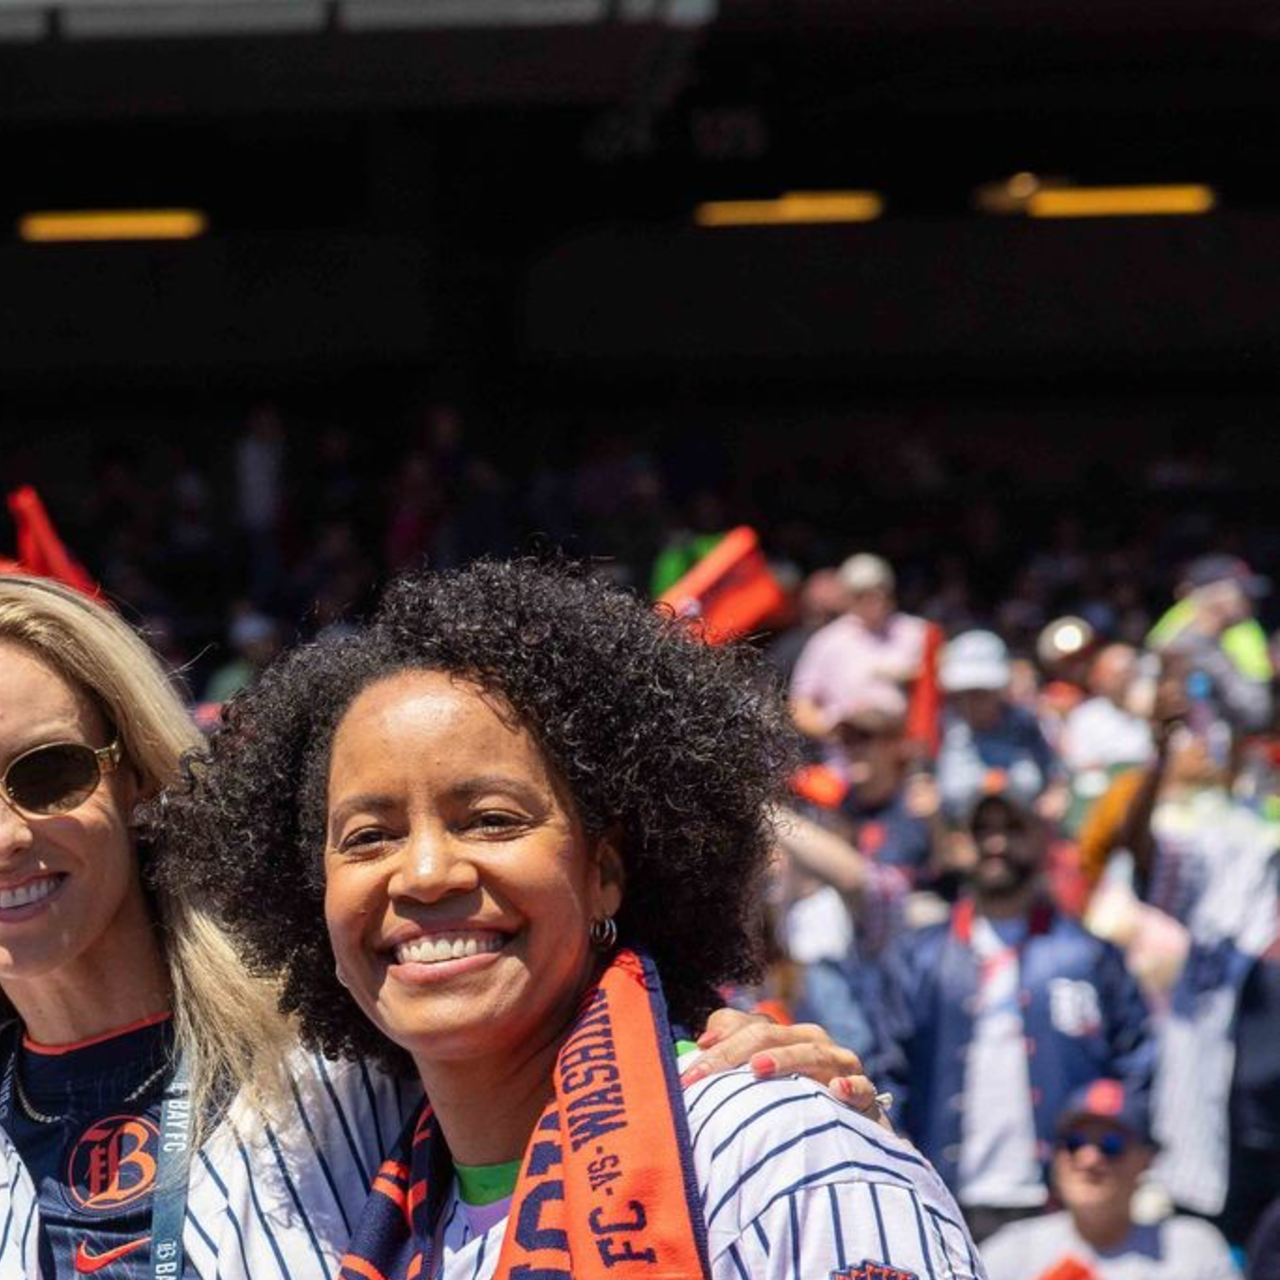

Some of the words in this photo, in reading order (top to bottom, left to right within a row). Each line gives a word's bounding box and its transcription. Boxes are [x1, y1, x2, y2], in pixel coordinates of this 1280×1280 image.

[166, 1099, 191, 1129] BAY
[163, 1133, 187, 1152] FC
[589, 1200, 658, 1269] FC
